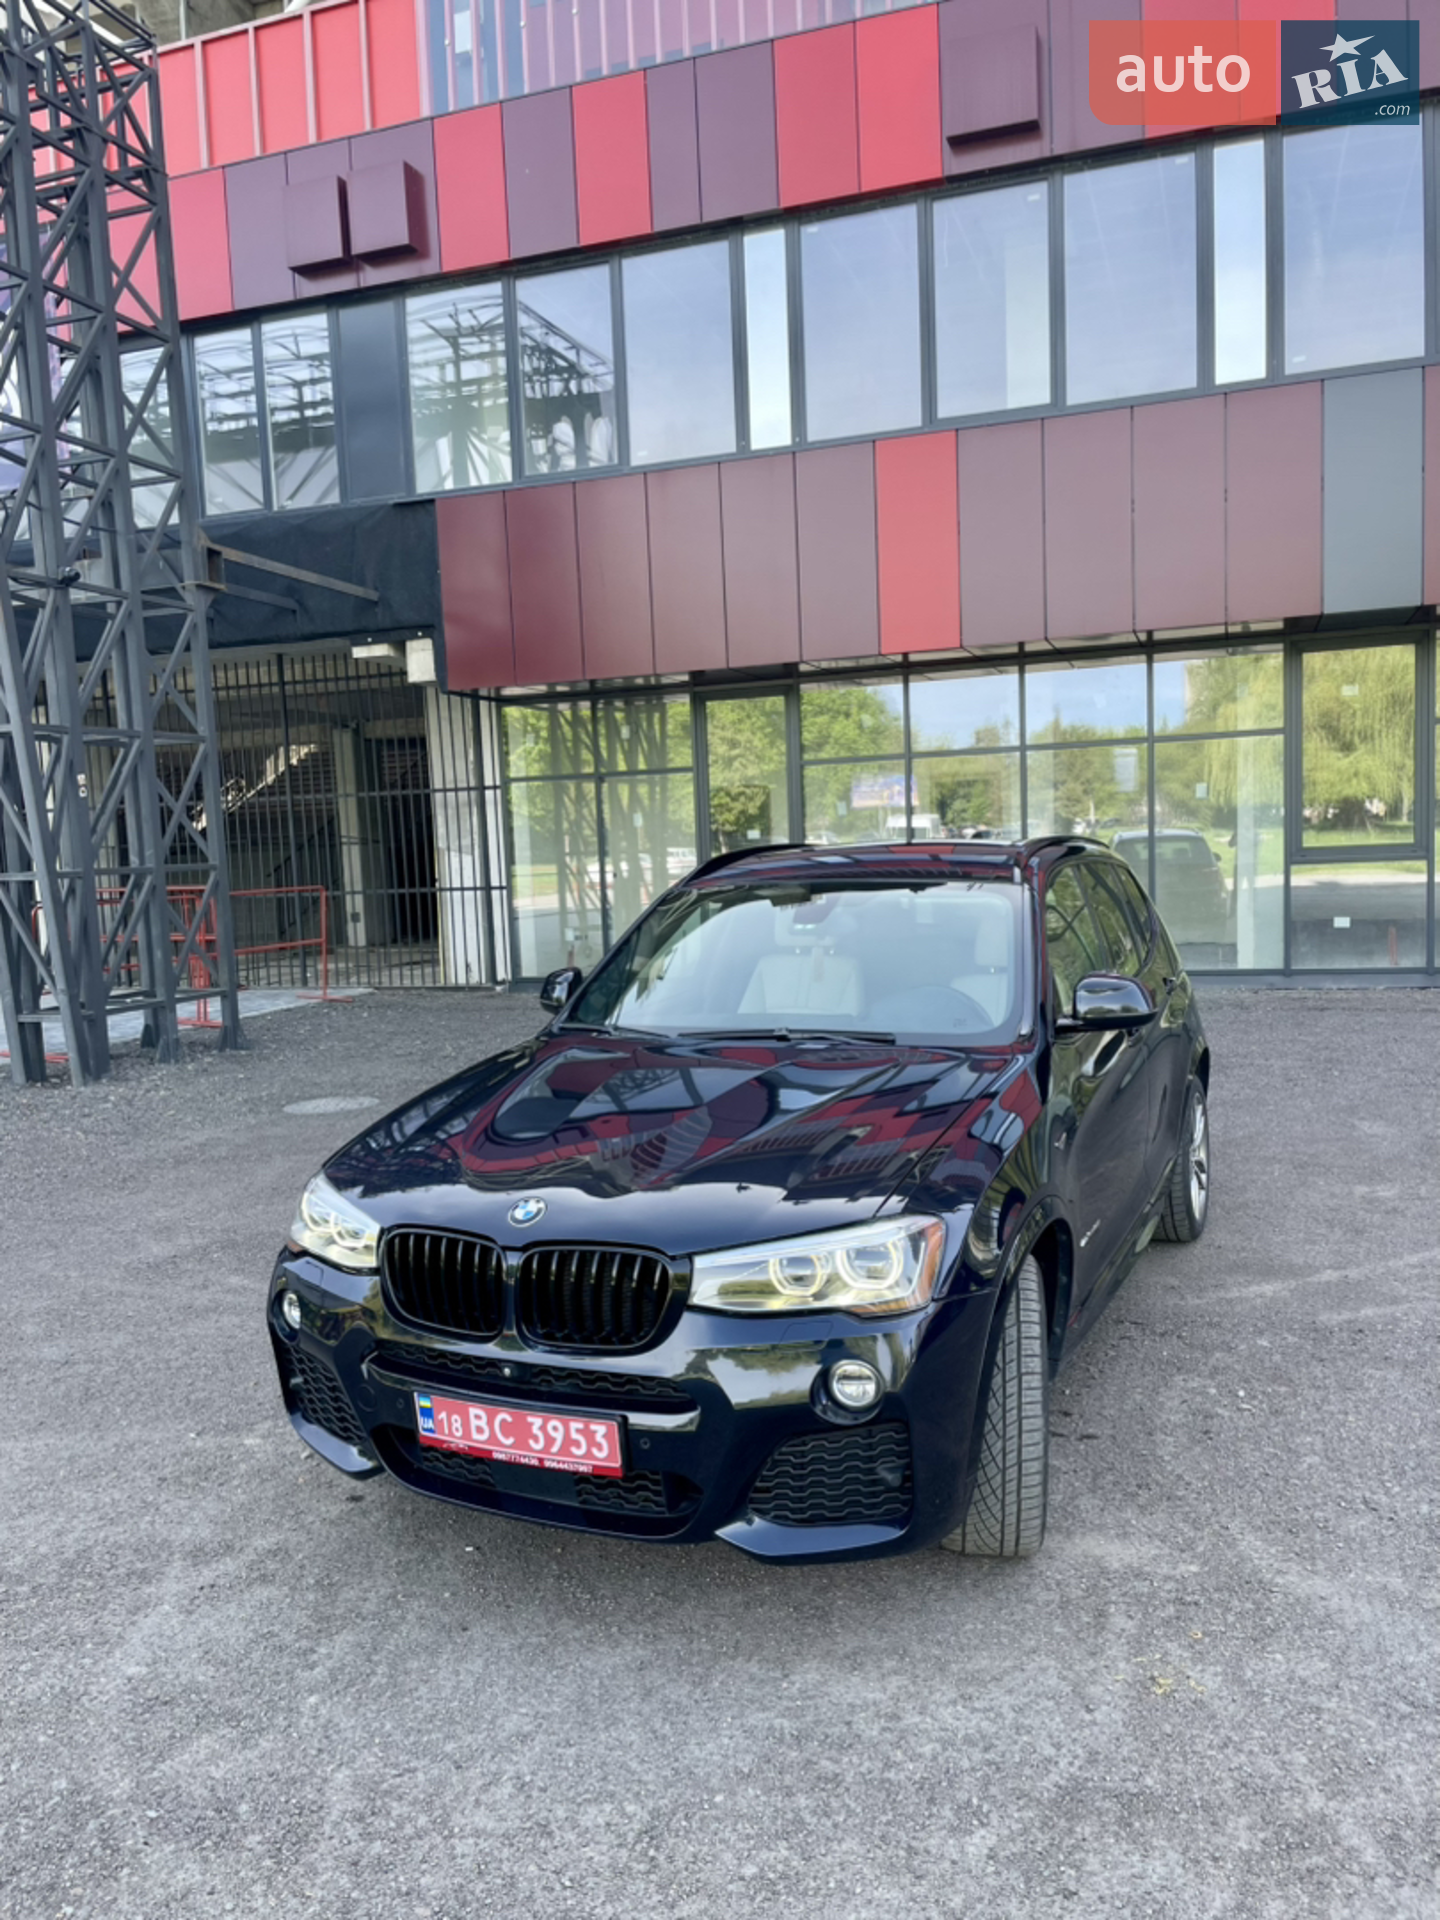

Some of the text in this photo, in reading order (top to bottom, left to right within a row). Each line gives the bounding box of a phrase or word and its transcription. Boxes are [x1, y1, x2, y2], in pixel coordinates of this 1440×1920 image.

[420, 1416, 435, 1430] UA
[438, 1406, 609, 1459] 18 BC 3953
